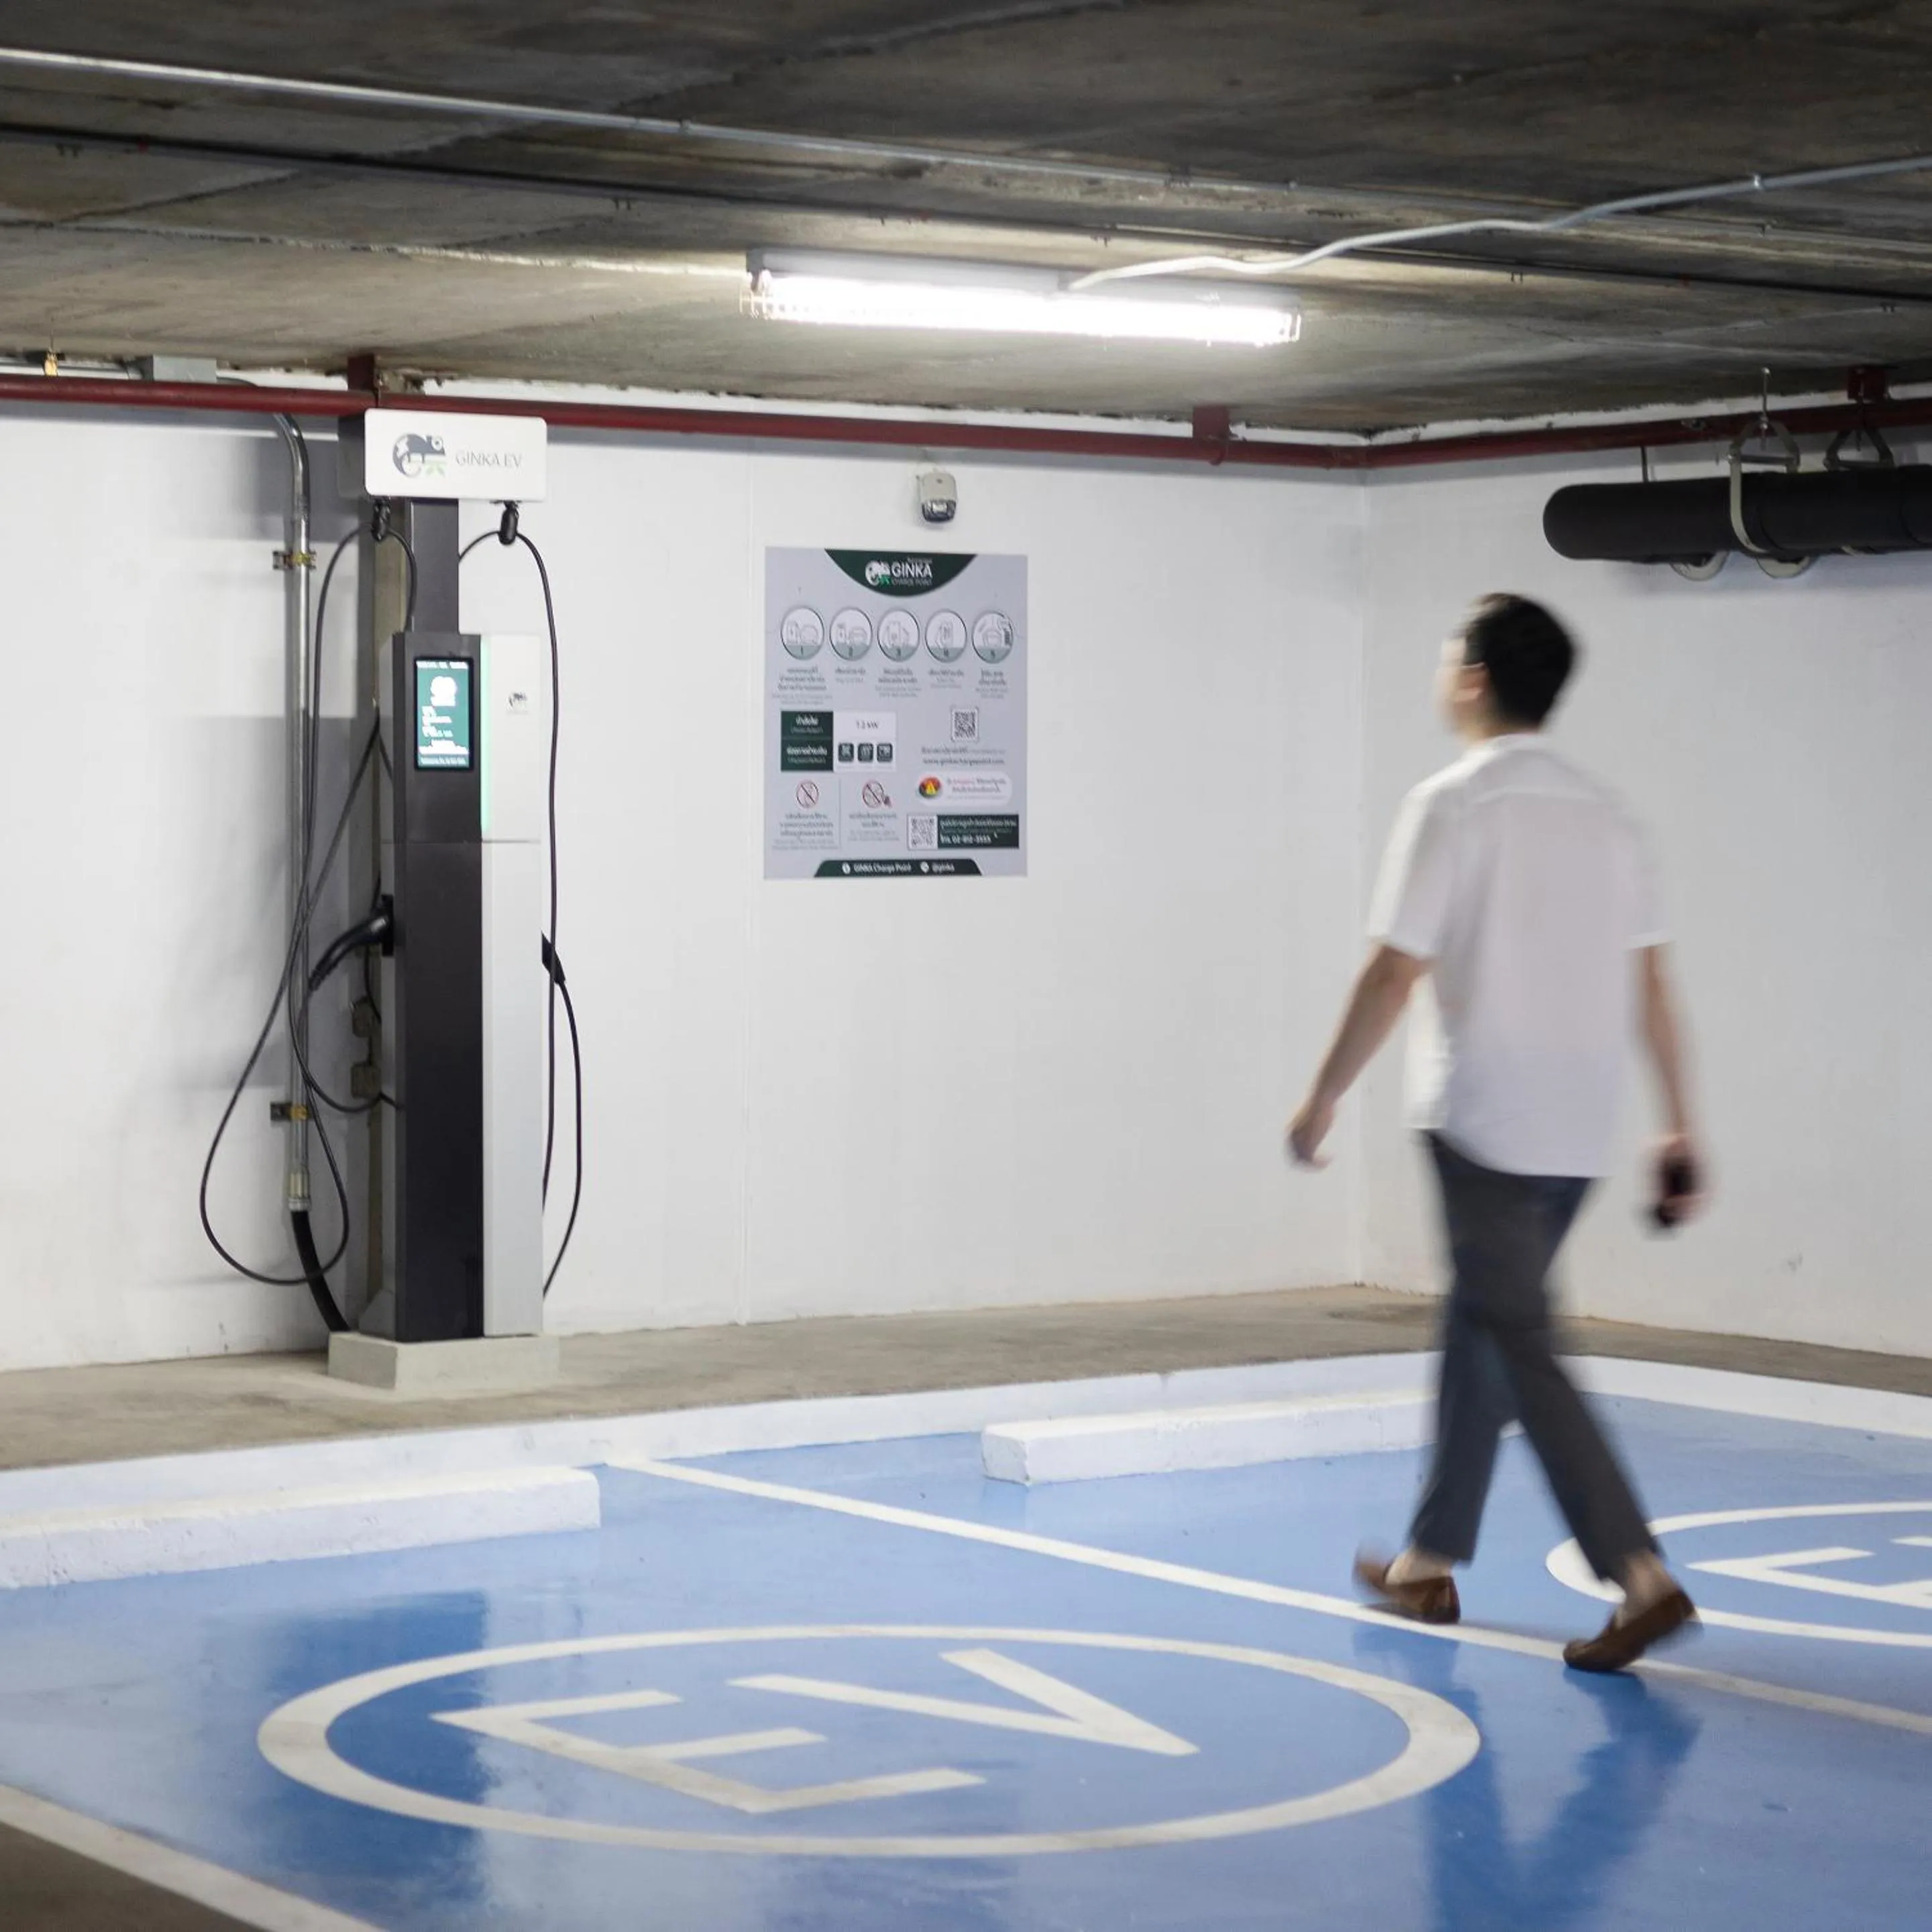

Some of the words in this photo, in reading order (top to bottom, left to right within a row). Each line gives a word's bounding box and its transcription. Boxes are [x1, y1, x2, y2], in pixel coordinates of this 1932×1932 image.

[455, 451, 500, 467] GINKA
[504, 453, 523, 468] EV
[891, 561, 932, 578] GINKA
[428, 1648, 1201, 1814] EV
